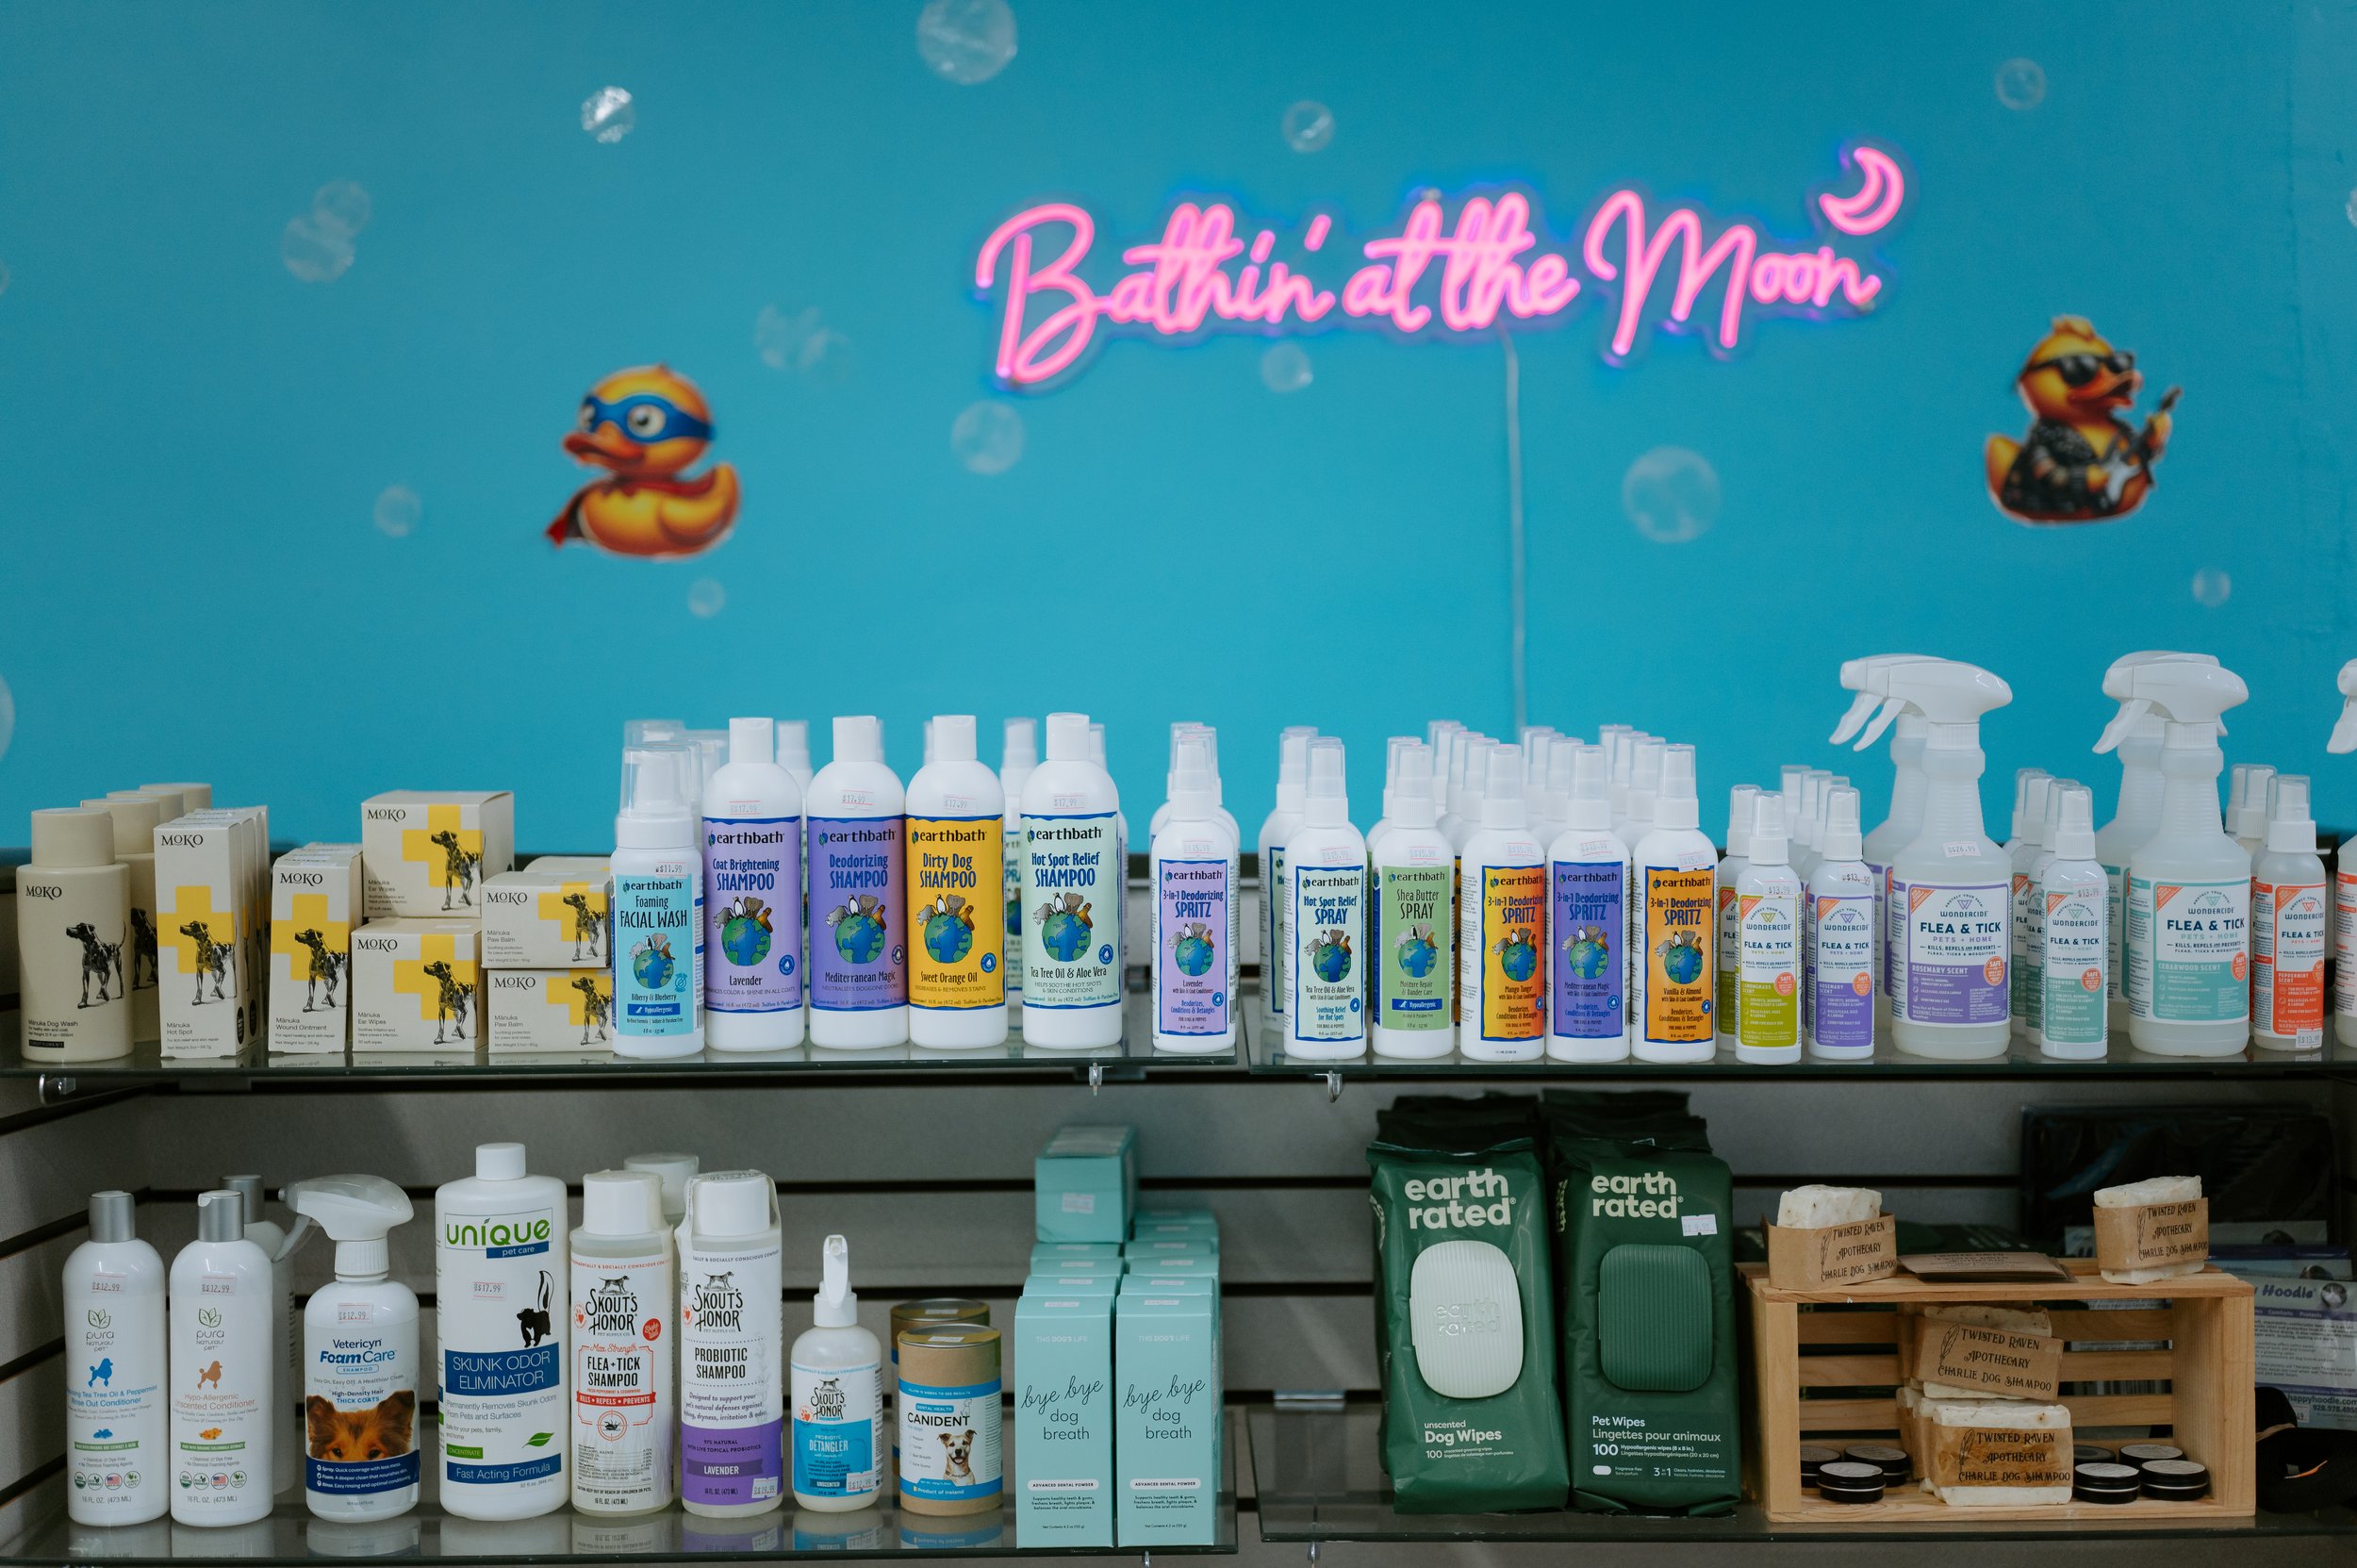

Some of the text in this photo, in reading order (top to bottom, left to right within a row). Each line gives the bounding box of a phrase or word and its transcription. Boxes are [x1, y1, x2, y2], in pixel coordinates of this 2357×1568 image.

[976, 190, 1880, 383] Bathin' at the Moon
[368, 809, 405, 822] MOKO
[717, 832, 784, 844] earthbath
[831, 829, 895, 842] earthbath
[920, 829, 986, 842] earthbath
[1036, 826, 1103, 840] earthbath
[161, 834, 204, 848] MOKO
[713, 859, 779, 872] Coat Brightening
[830, 854, 888, 868] Deodorizing
[923, 853, 972, 870] Dirty Dog
[1031, 852, 1100, 867] Hot Spot Relief
[280, 873, 322, 886] MOKO
[717, 873, 774, 890] SHAMPOO
[831, 870, 887, 888] SHAMPOO
[920, 871, 976, 888] SHAMPOO
[1036, 868, 1095, 887] SHAMPOO
[1174, 871, 1222, 880] earthbath
[1311, 877, 1359, 887] earthbath
[1397, 872, 1445, 882] earthbath
[1662, 878, 1710, 887] earthbath
[26, 885, 62, 900] MOKO
[631, 881, 683, 890] earthbath
[487, 893, 527, 905] MOKO
[1163, 891, 1223, 901] 3-in-1 Deodorizing
[1397, 889, 1439, 900] Shea Butter
[636, 896, 668, 909] Foaming
[1304, 896, 1357, 908] Hot Spot Relief
[1651, 898, 1711, 908] 3-in-1 Deodorizing
[1176, 902, 1211, 917] SPRITZ
[1401, 904, 1434, 920] SPRAY
[620, 910, 686, 928] FACIAL WASH
[1315, 909, 1347, 925] SPRAY
[1664, 909, 1701, 925] SPRITZ
[1920, 922, 2001, 933] FLEA & TICK
[2167, 918, 2244, 932] FLEA & TICK
[826, 971, 895, 982] Mediterranean Magic
[921, 972, 977, 983] Sweet Orange Oil
[1040, 967, 1053, 978] Tree
[1055, 967, 1064, 978] Oil
[1067, 968, 1074, 978] &
[1077, 967, 1091, 977] Aloe
[1093, 966, 1106, 976] Vera
[730, 975, 762, 986] Lavender
[1405, 1168, 1508, 1200] earth
[1591, 1171, 1676, 1194] earth
[503, 1246, 535, 1257] pet care
[585, 1289, 637, 1315] SKOUT'S
[693, 1285, 743, 1312] SKOUT'S
[589, 1314, 635, 1336] HONOR
[696, 1310, 741, 1332] HONOR
[86, 1330, 114, 1341] pura
[1962, 1329, 2040, 1350] TWISTED RAVEN
[333, 1339, 382, 1349] Vetericyn
[453, 1351, 550, 1372] SKUNK ODOR
[695, 1348, 747, 1362] PROBIOTIC
[1964, 1350, 2030, 1369] APOTHECARY
[697, 1364, 746, 1379] SHAMPOO
[1938, 1365, 2052, 1392] CHARLIE DOG SHAMPOO
[459, 1373, 544, 1391] ELIMINATOR
[588, 1373, 637, 1386] SHAMPOO
[1021, 1375, 1103, 1412] bye bye
[447, 1395, 556, 1411] Permanently Removes Skunk Odors
[908, 1412, 970, 1427] CANIDENT
[1050, 1410, 1079, 1425] dog
[1425, 1420, 1466, 1428] unscented
[1592, 1416, 1645, 1428] Pet Wipes
[1044, 1426, 1090, 1440] breath
[1425, 1429, 1502, 1446] Dog Wipes
[1592, 1428, 1721, 1442] Lingettes pour animaux
[1977, 1432, 2055, 1444] TWISTED RAVEN
[809, 1440, 848, 1452] DETANGLER
[1592, 1444, 1618, 1456] 100
[1426, 1450, 1442, 1459] 100
[1984, 1451, 2047, 1464] APOTHECARY
[456, 1463, 550, 1481] Fast Acting Formula
[704, 1466, 739, 1475] LAVENDER
[1959, 1471, 2070, 1483] CHARLIE DOG SHAMPOO
